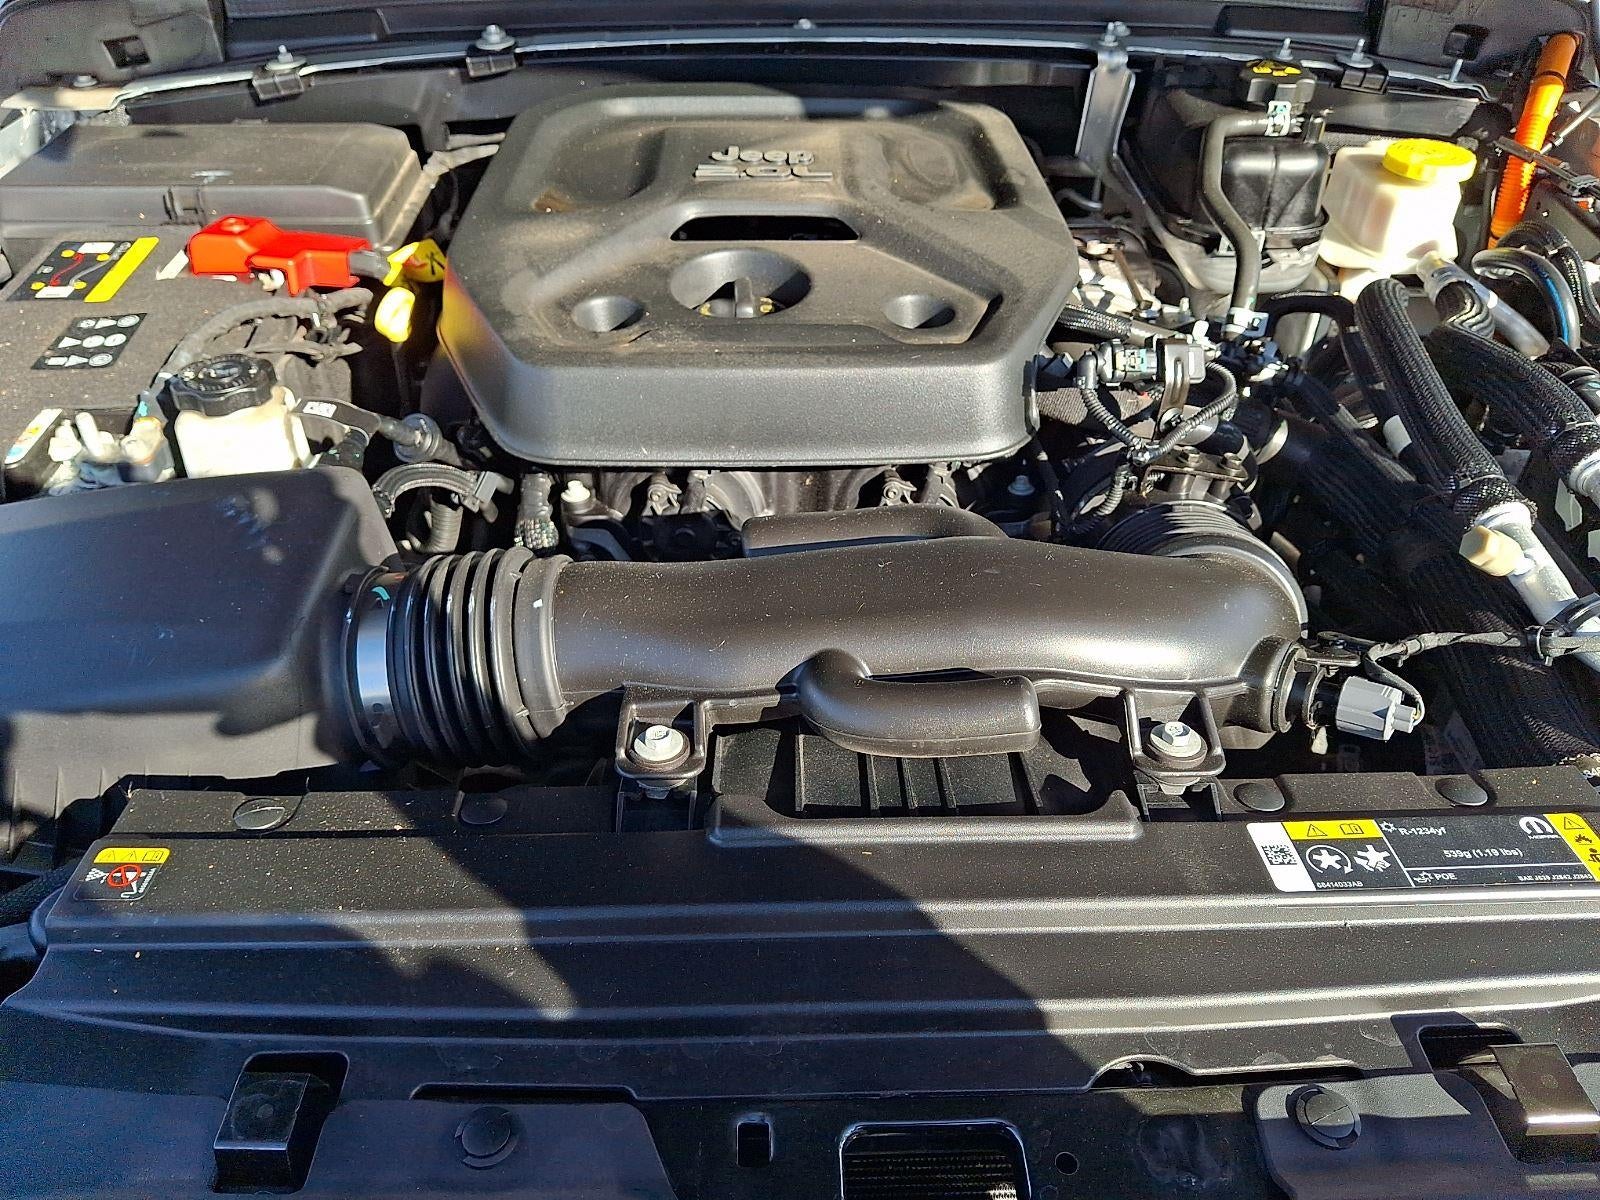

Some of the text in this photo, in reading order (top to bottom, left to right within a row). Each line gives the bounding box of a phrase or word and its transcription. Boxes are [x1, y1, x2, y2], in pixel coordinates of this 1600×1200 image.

[710, 145, 815, 165] Jeep
[1398, 826, 1447, 836] R-1234yf
[1442, 849, 1473, 859] 539g
[1500, 847, 1524, 858] lbs)
[1433, 872, 1458, 880] POE
